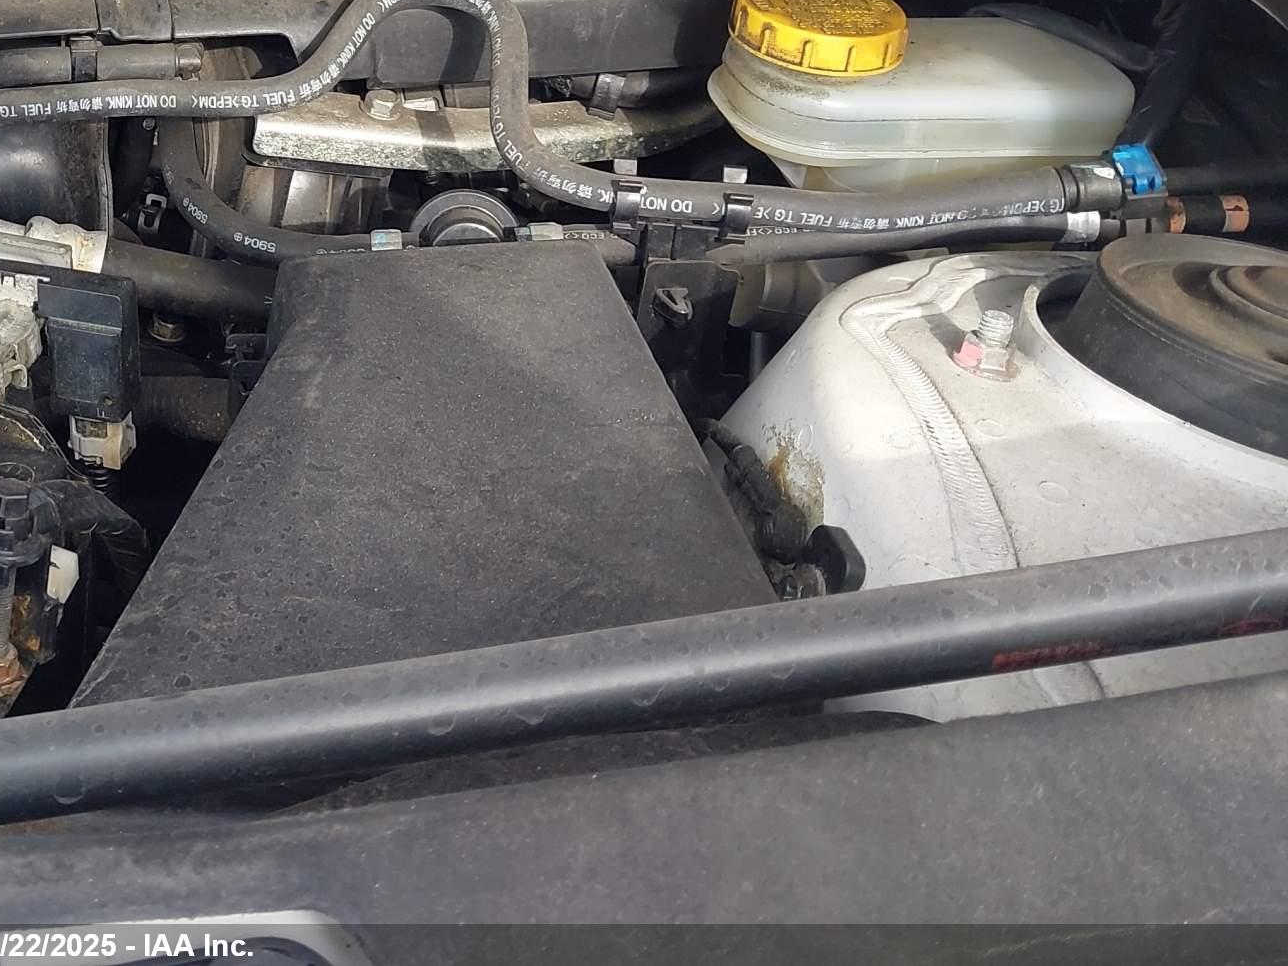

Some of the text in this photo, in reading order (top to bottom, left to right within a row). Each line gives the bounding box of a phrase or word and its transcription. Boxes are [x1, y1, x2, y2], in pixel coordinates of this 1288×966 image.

[362, 11, 375, 29] DO
[350, 23, 366, 49] NOT
[133, 94, 158, 107] NOT
[160, 94, 176, 107] DO
[241, 94, 259, 107] TG
[262, 88, 295, 105] FUEL
[0, 105, 17, 117] TG
[20, 102, 51, 116] FUEL
[188, 203, 208, 224] 5904
[671, 200, 692, 213] DO
[775, 209, 796, 223] TG
[800, 212, 832, 227] FUEL
[243, 235, 276, 252] 5904
